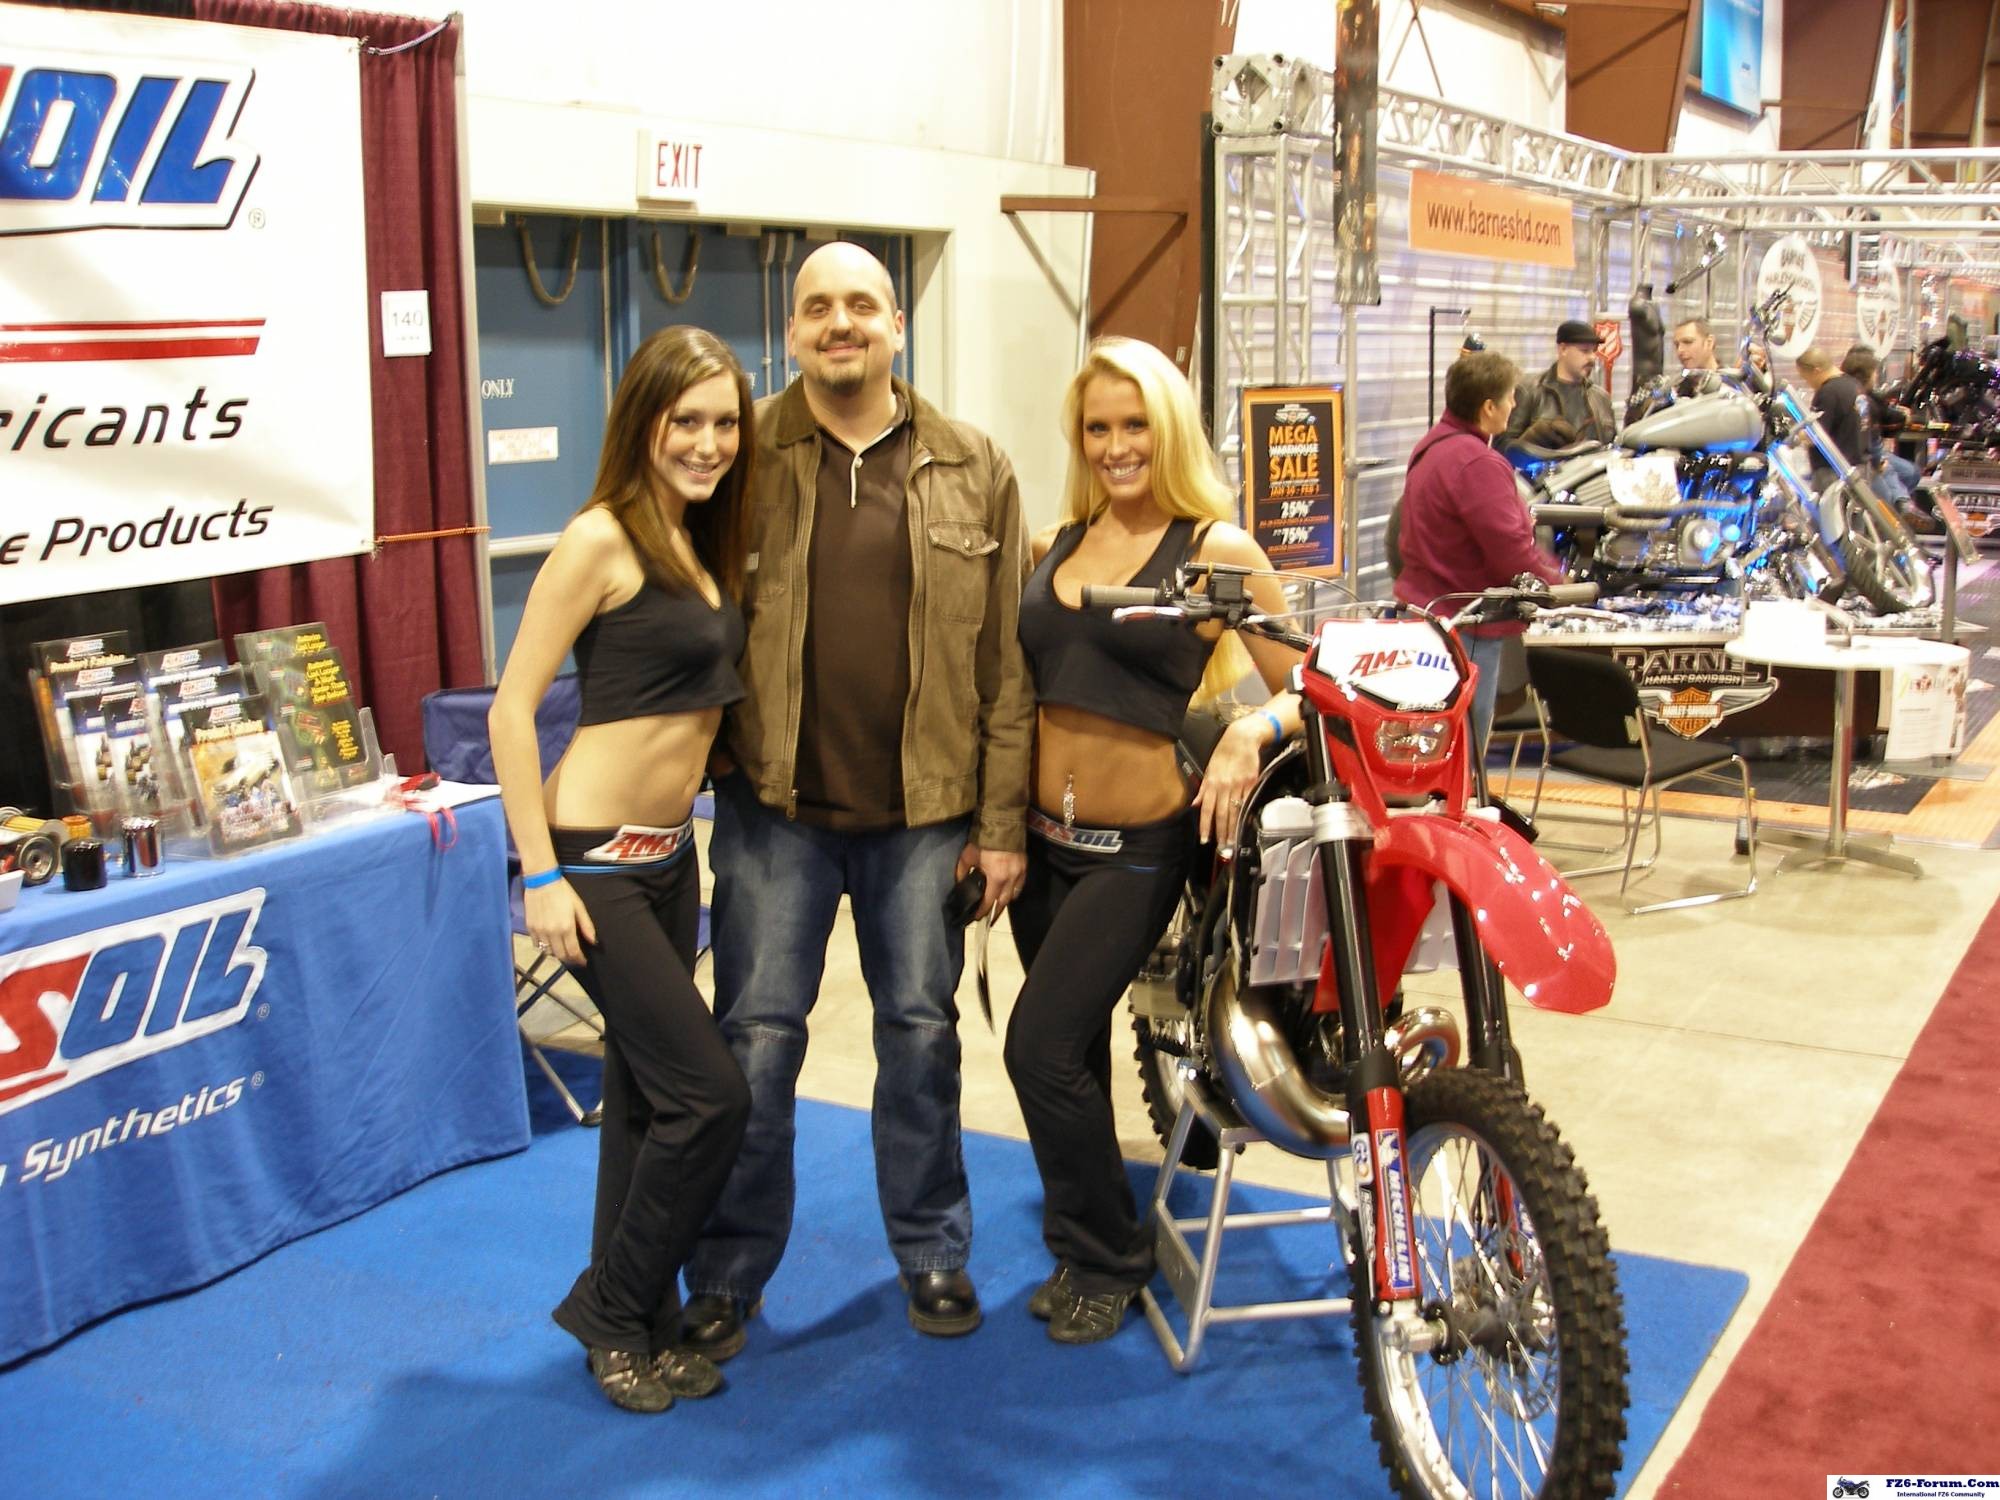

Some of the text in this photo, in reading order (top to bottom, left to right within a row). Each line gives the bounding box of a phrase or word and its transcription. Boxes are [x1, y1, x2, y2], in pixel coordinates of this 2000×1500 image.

[656, 142, 703, 188] EXIT
[1427, 200, 1561, 247] www.barneshd.com
[392, 310, 424, 327] 140
[481, 378, 514, 399] ONLY
[1268, 424, 1319, 445] MEGA
[1269, 453, 1319, 481] SALE
[40, 498, 274, 561] Products
[1350, 650, 1450, 677] AMSOIL
[20, 1076, 246, 1183] Synthetics
[1388, 1169, 1411, 1282] MICHELIN
